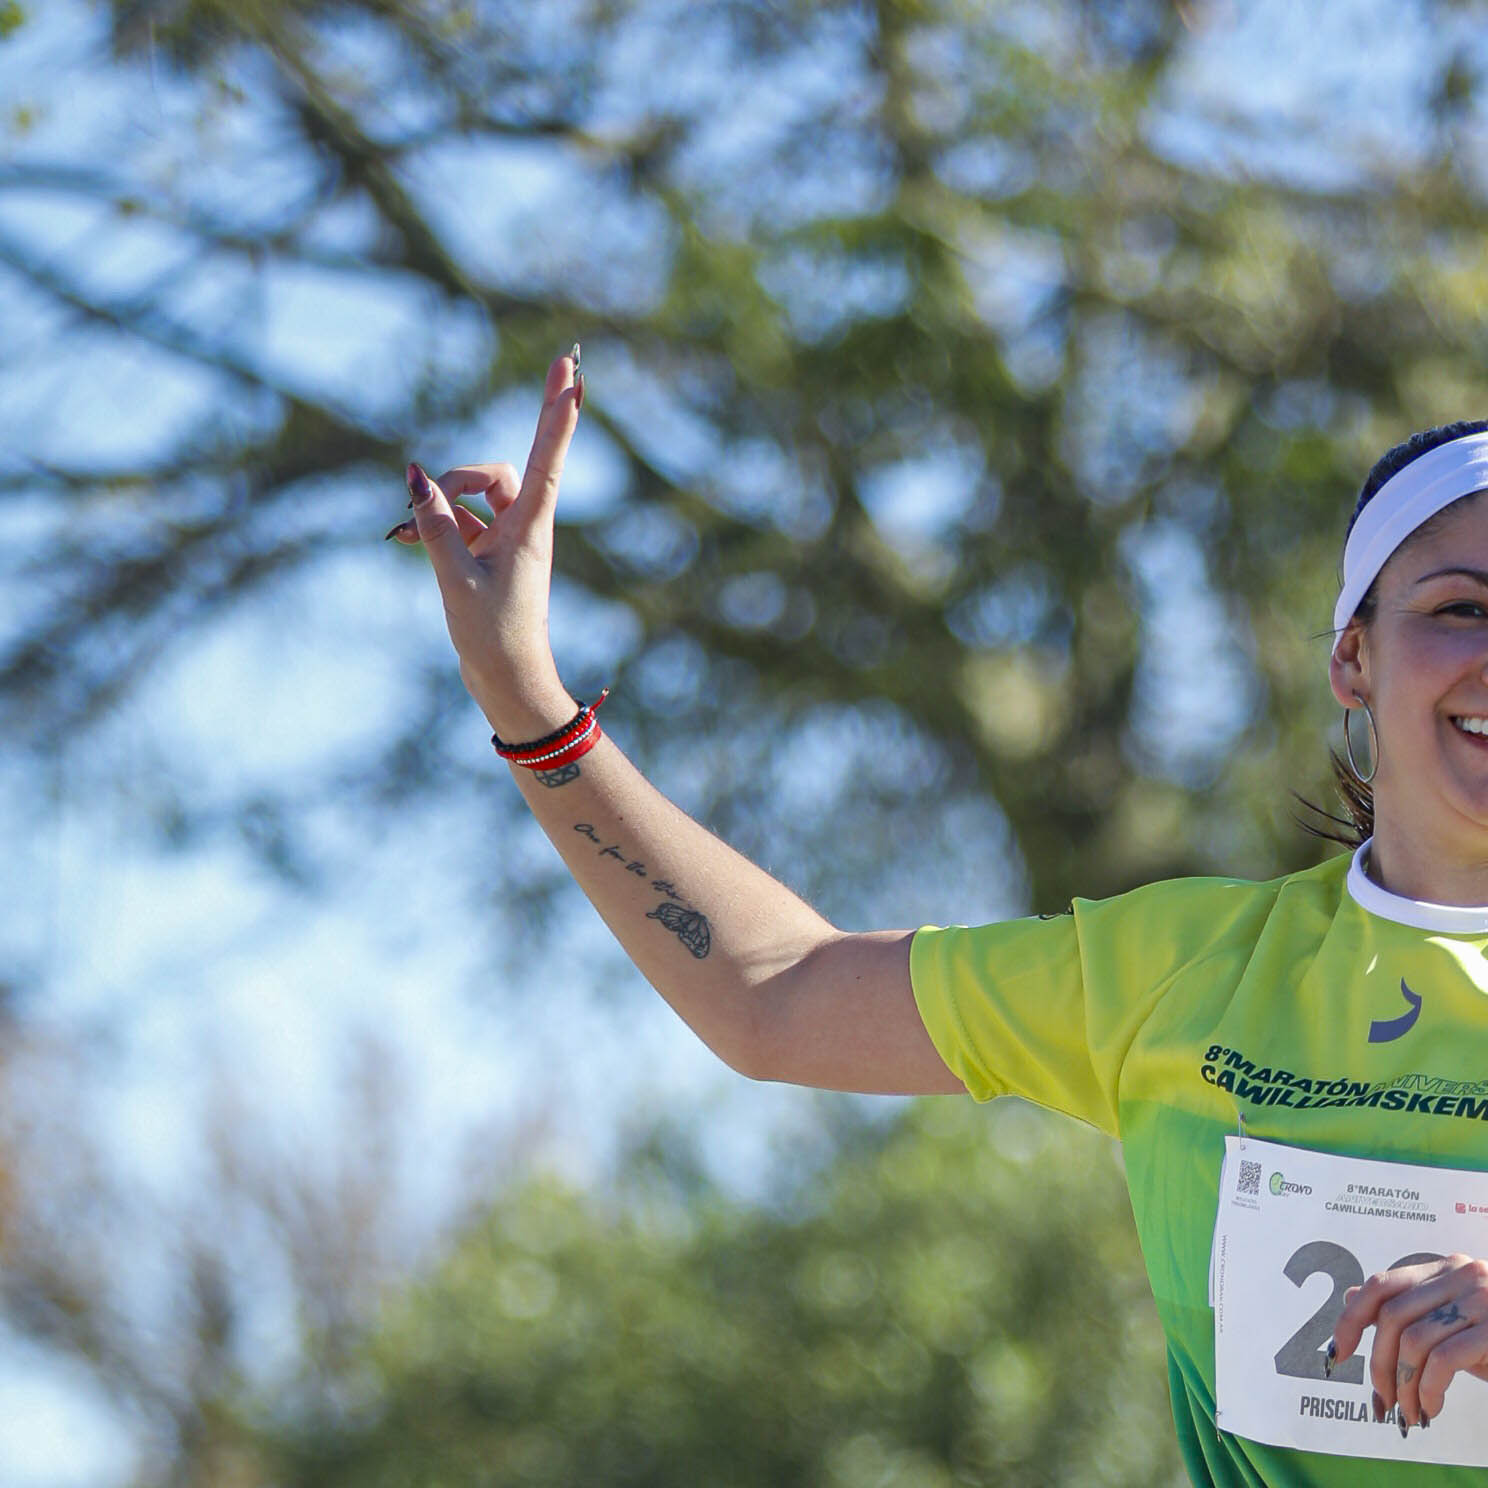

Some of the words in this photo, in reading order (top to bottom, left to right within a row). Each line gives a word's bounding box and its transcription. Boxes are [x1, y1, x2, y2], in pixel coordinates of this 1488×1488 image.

[1324, 1201, 1438, 1223] CAWILLIAMSKEMMIS
[1468, 1203, 1478, 1213] la
[1300, 1395, 1369, 1423] PRISCILA
